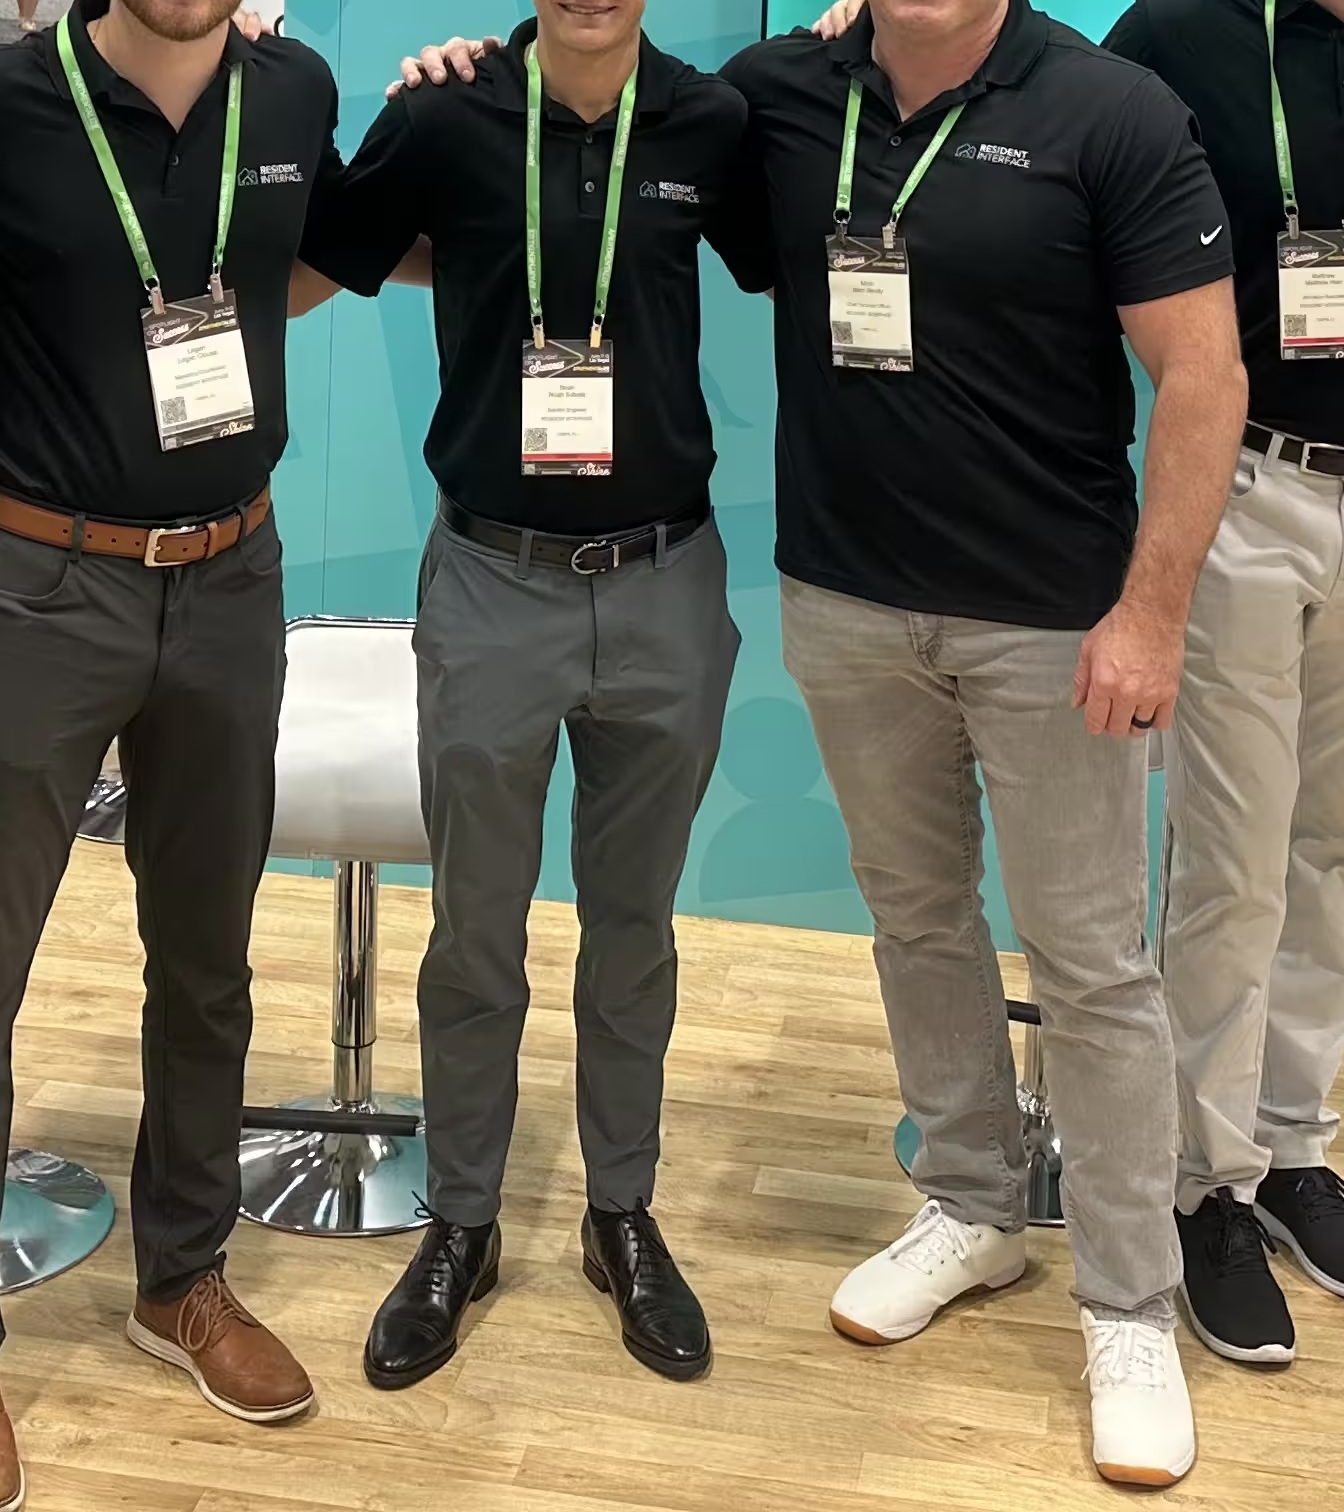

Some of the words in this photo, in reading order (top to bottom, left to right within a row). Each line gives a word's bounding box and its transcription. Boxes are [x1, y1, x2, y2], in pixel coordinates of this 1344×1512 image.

[980, 143, 1029, 159] RESIDENT
[976, 152, 1031, 168] INTERFACE
[259, 163, 298, 175] RESIDENT
